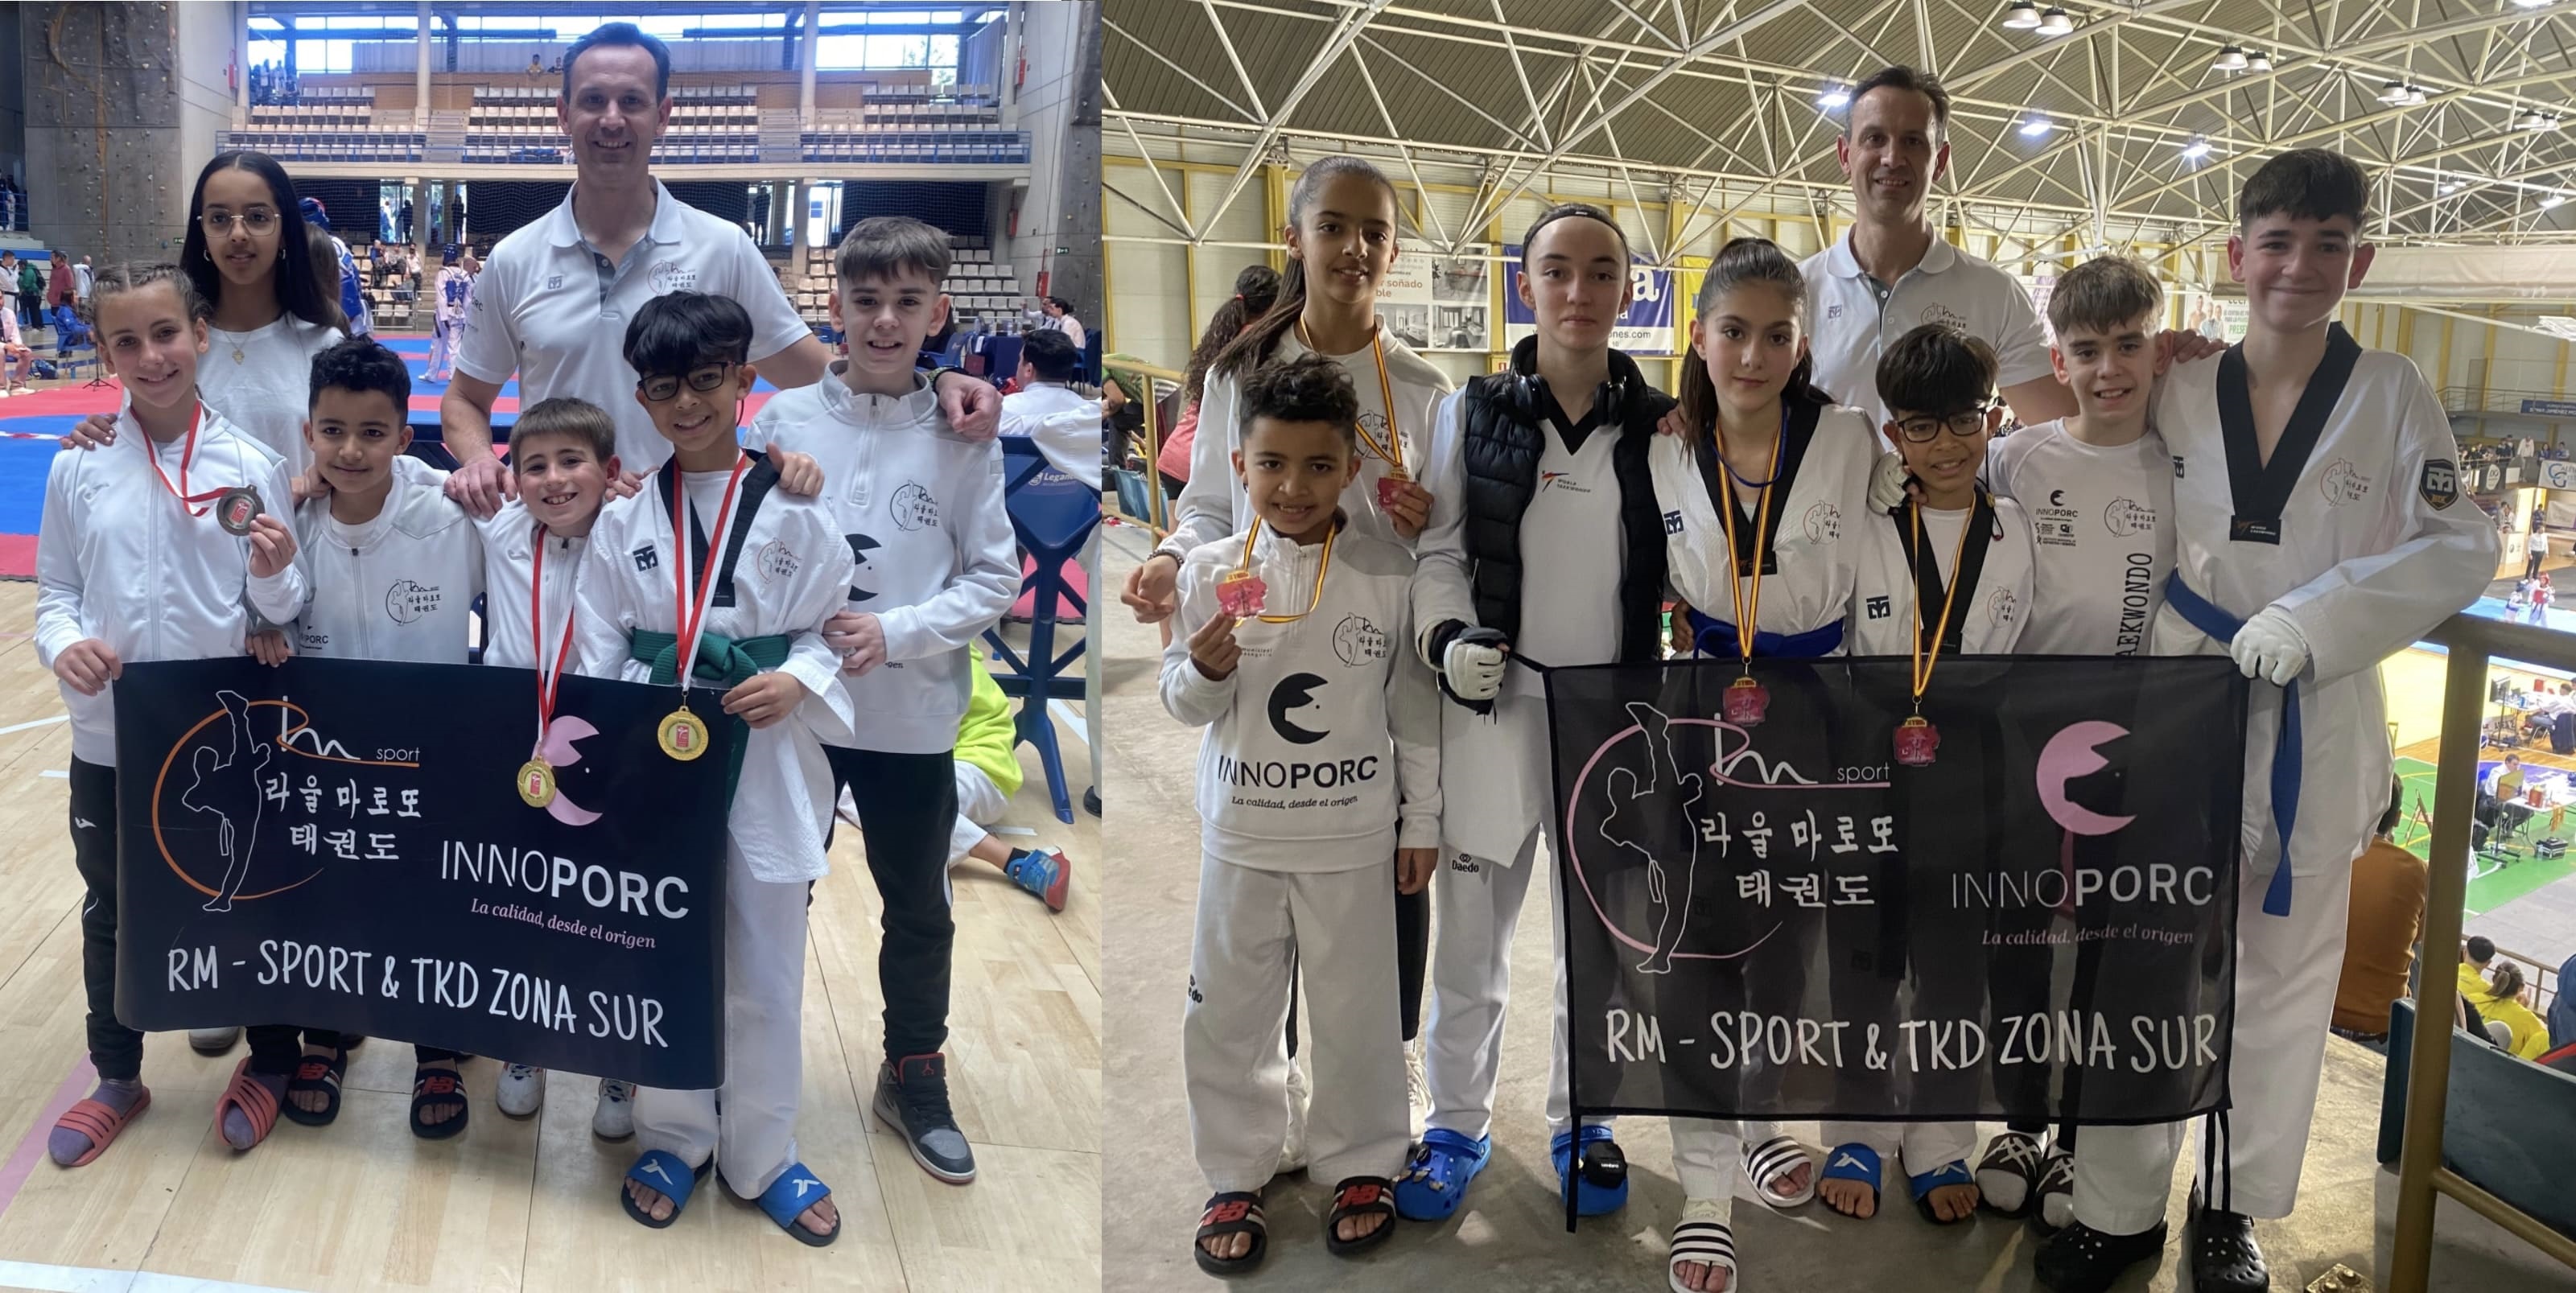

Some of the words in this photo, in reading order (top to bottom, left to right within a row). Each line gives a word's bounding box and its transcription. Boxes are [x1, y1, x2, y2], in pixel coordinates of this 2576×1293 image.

[1387, 279, 1424, 289] soñado
[2035, 508, 2078, 517] INNOPORC
[376, 747, 420, 764] sport
[1218, 755, 1379, 789] INNOPORC
[1837, 762, 1890, 785] sport
[1232, 796, 1243, 805] La
[1247, 797, 1285, 810] calidad,
[1288, 799, 1317, 809] desde
[1320, 798, 1328, 807] el
[1330, 796, 1358, 808] origen
[290, 823, 400, 860] 태권도
[442, 840, 690, 919] INNOPORC
[1452, 859, 1479, 873] Daedo
[1735, 869, 1875, 908] 태권도
[1953, 863, 2214, 908] INNOPORC
[471, 898, 488, 915] La
[492, 904, 545, 929] calidad,
[547, 914, 587, 937] desde
[590, 924, 604, 940] el
[605, 930, 656, 949] origen
[1982, 930, 2001, 945] La
[2075, 924, 2119, 943] desde
[2123, 923, 2137, 940] el
[2141, 925, 2194, 945] origen
[168, 945, 218, 991] RM
[258, 939, 372, 996] SPORT
[381, 955, 400, 999] &
[410, 957, 479, 1008] TKD
[488, 968, 577, 1034] ZONA
[588, 990, 668, 1048] SUR
[1605, 1009, 1667, 1064] RM
[1710, 1010, 1850, 1069] SPORT
[1865, 1023, 1888, 1071] &
[1898, 1019, 1986, 1073] TKD
[2000, 1009, 2117, 1070] ZONA
[2131, 1013, 2218, 1073] SUR
